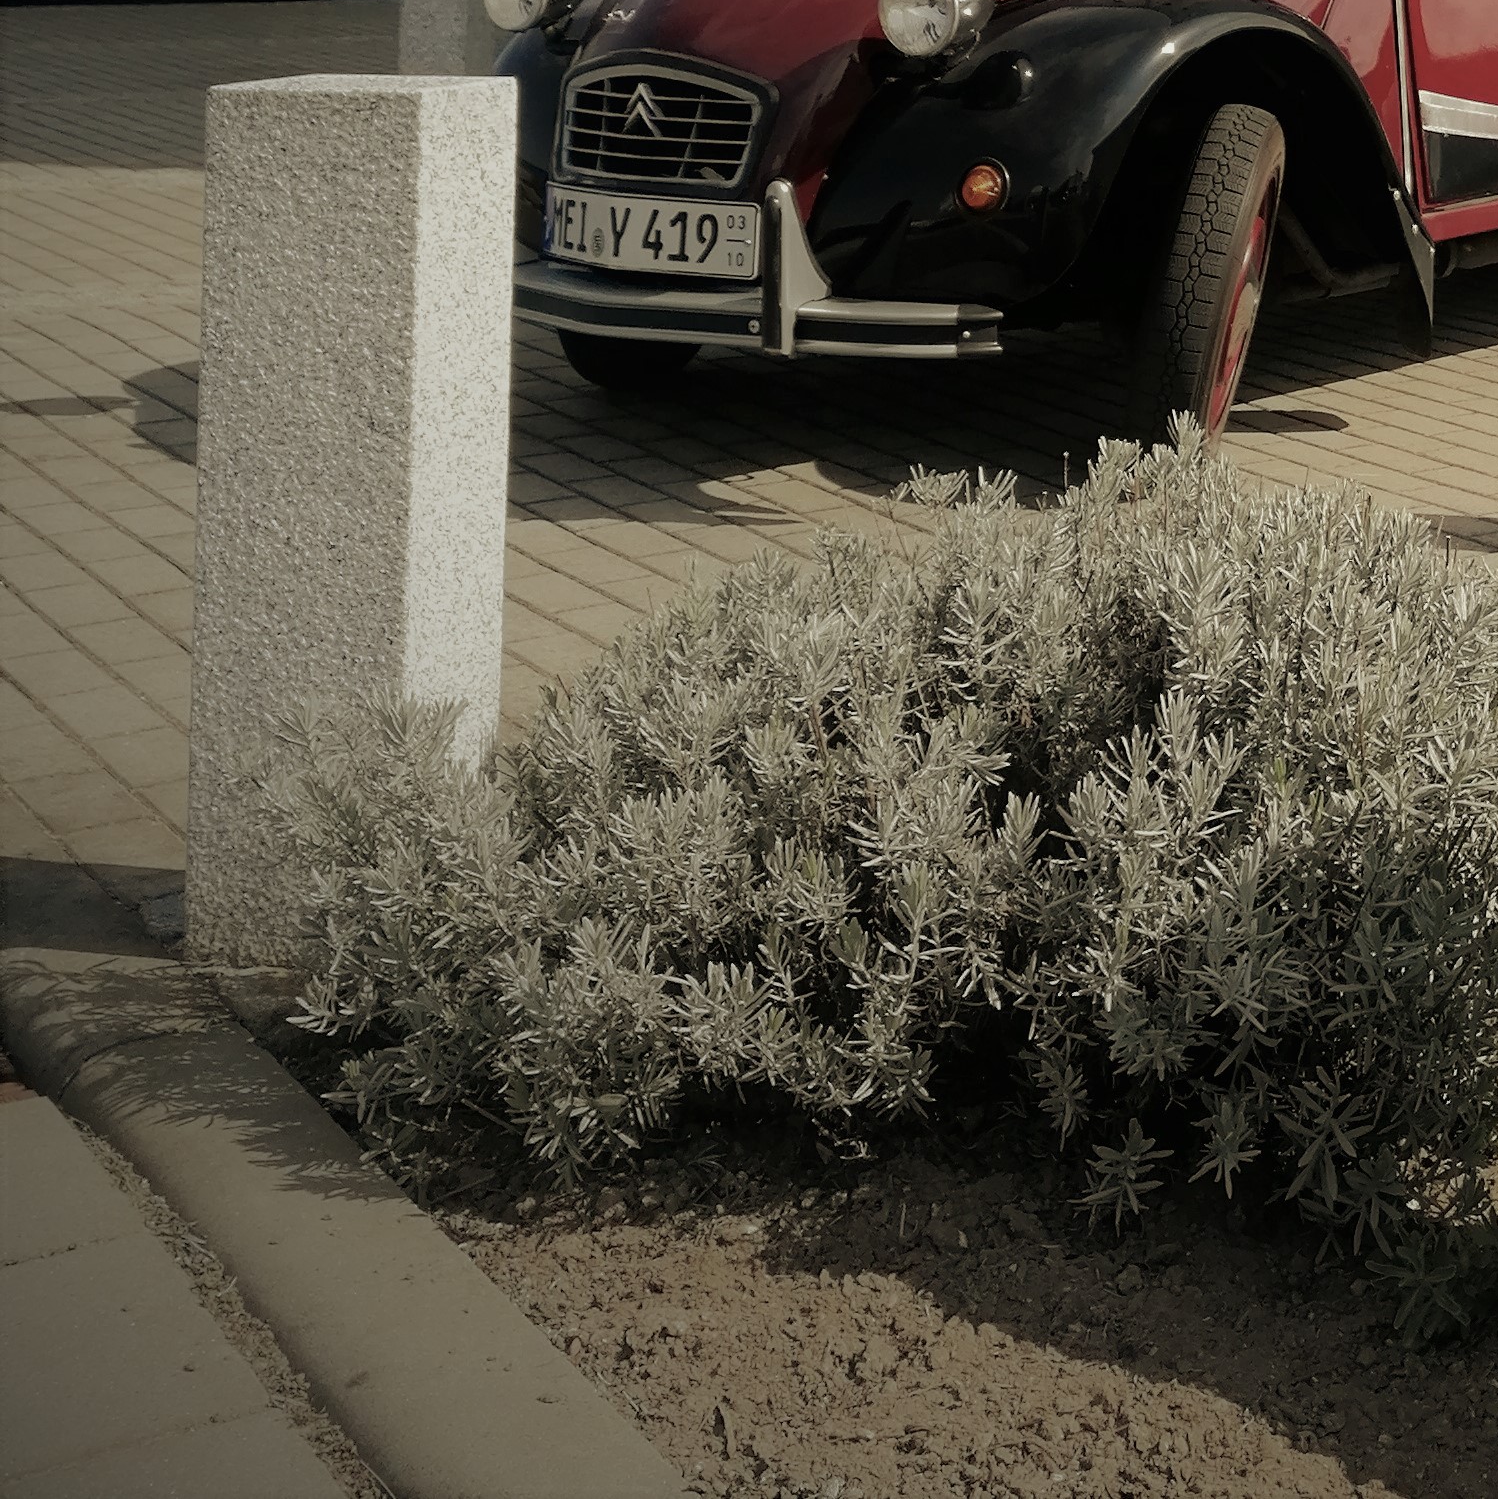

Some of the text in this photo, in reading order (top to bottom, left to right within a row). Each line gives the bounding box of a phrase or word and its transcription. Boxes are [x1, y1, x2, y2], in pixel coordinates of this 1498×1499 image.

[553, 196, 588, 253] MEI
[610, 206, 632, 257] Y
[641, 209, 719, 263] 419
[727, 215, 746, 230] 03
[727, 252, 745, 267] 10
